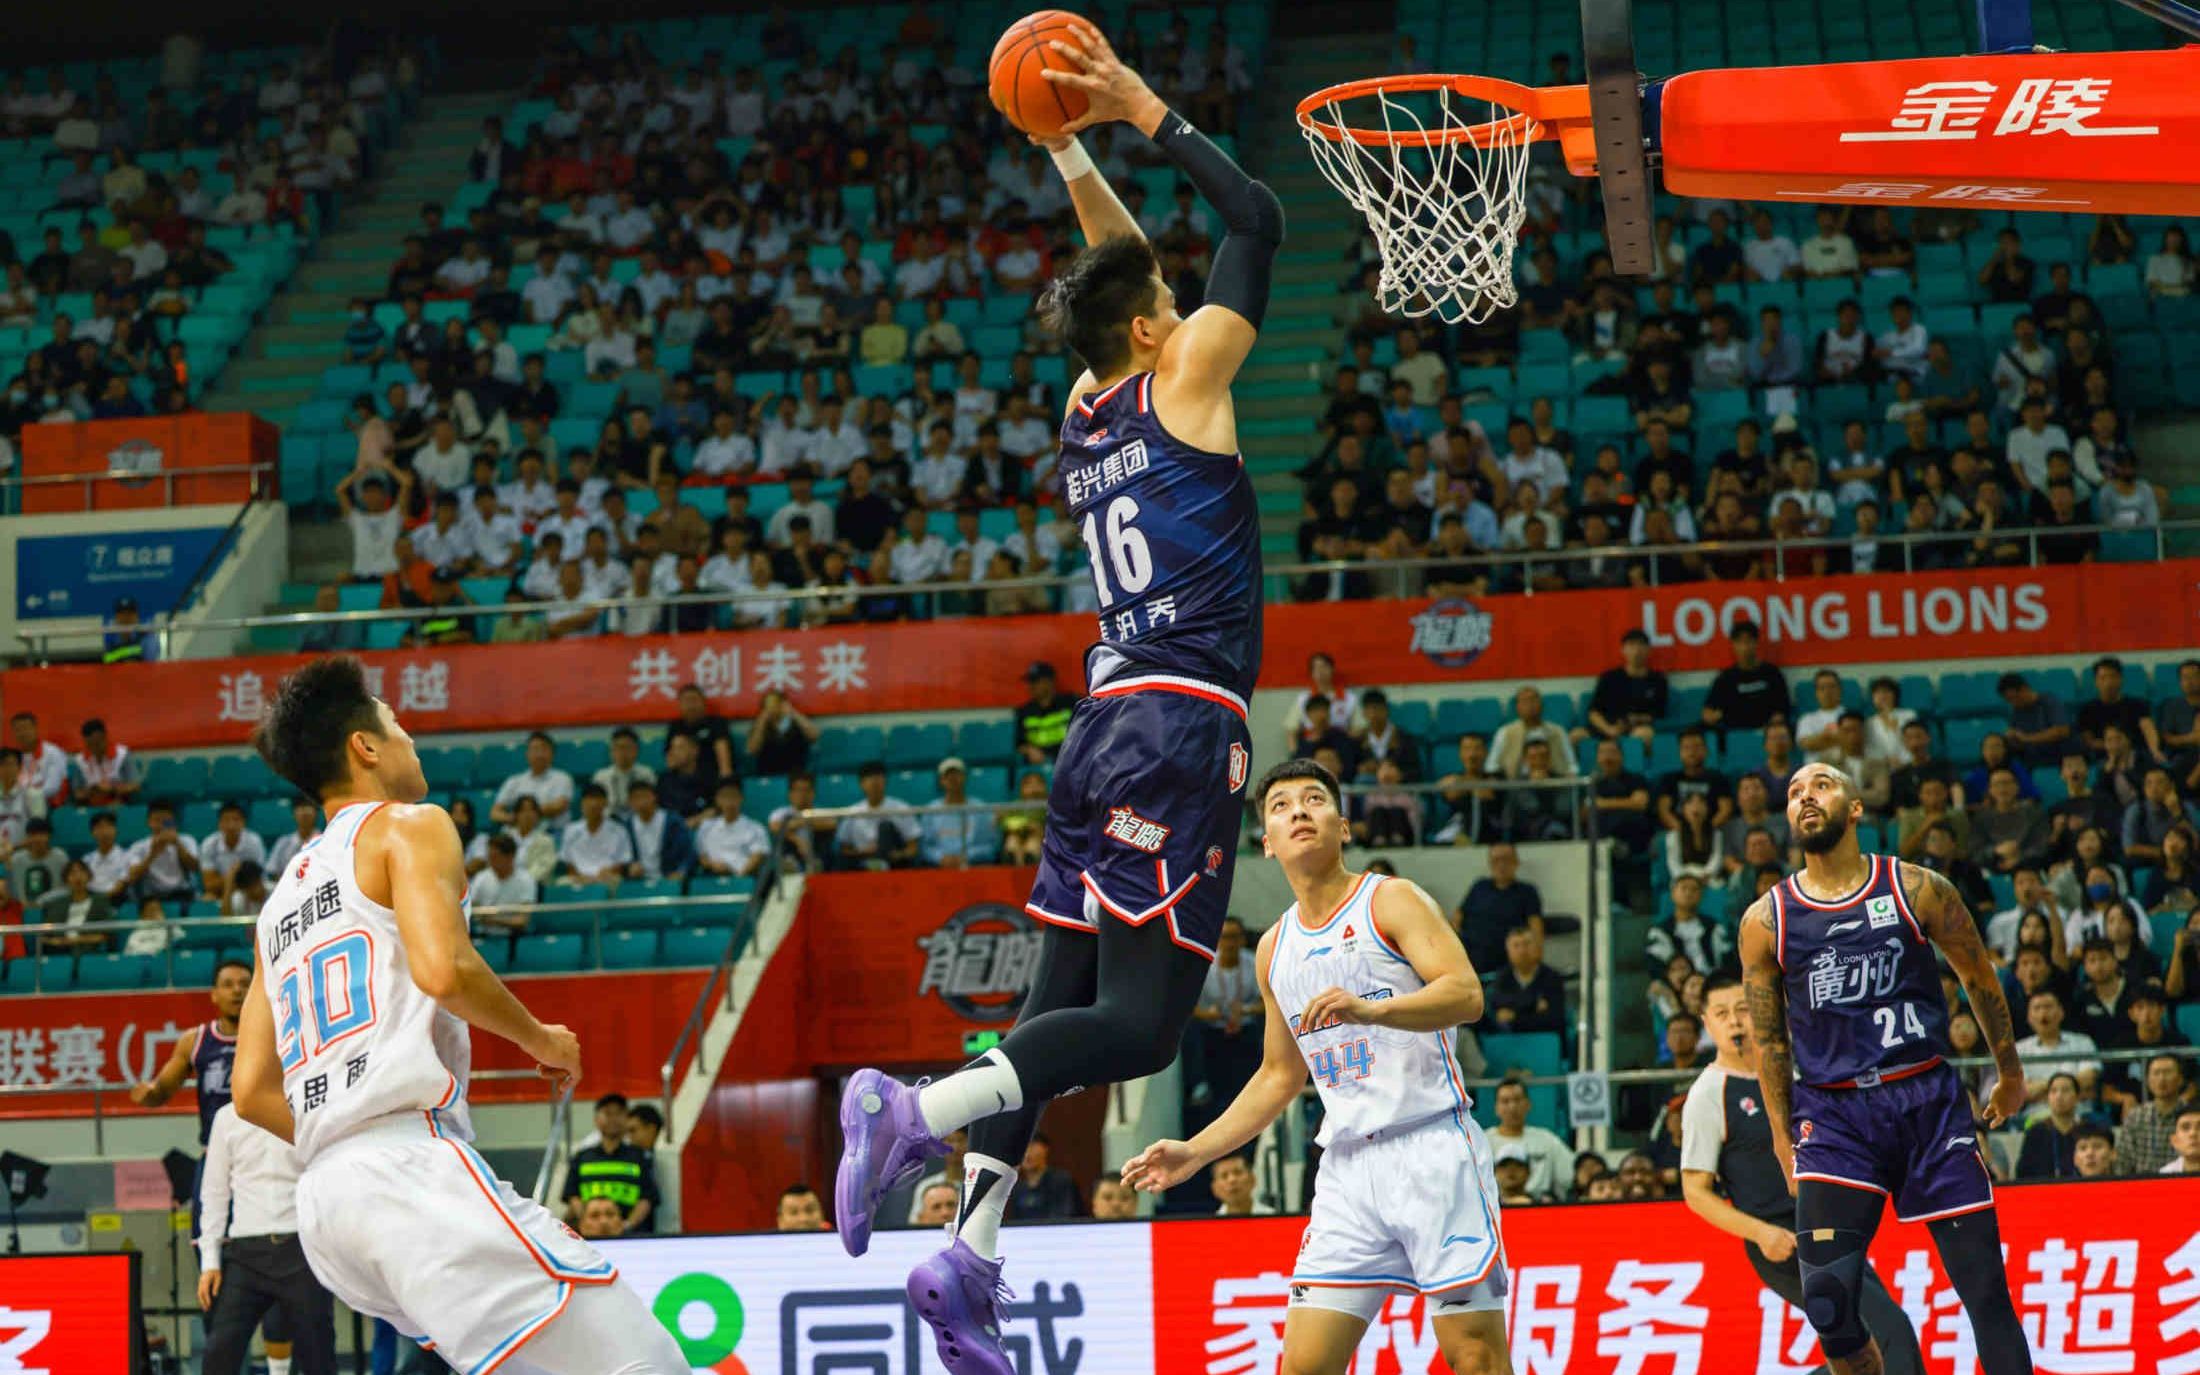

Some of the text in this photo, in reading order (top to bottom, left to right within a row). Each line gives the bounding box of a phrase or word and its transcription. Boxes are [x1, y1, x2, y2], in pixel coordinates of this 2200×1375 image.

[1840, 78, 2159, 141] 金陵
[1083, 495, 1153, 608] 16
[1642, 584, 2049, 648] LOONG LIONS
[218, 642, 868, 721] 追越 共创未来
[1873, 1002, 1926, 1049] 24
[287, 1051, 369, 1116] 思雨
[1309, 1037, 1376, 1089] 44
